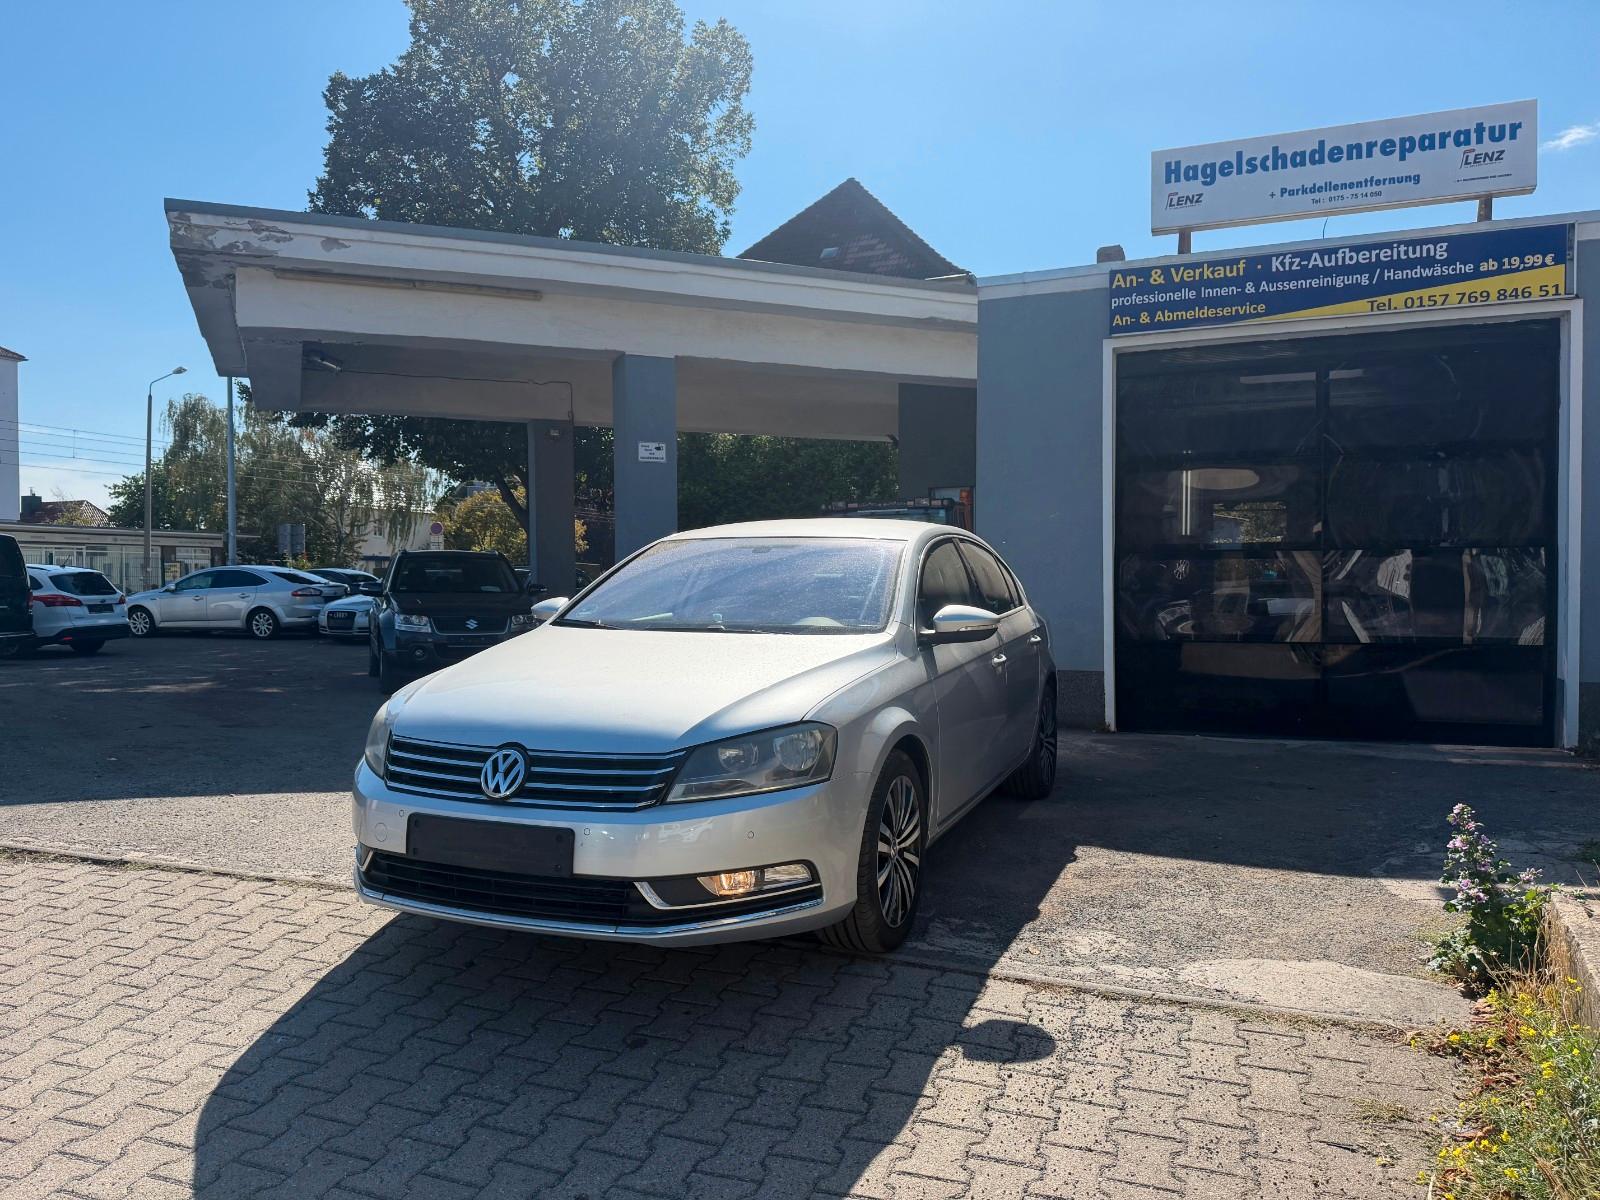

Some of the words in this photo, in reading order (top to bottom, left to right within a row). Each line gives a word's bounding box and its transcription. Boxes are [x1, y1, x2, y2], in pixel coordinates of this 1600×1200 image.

[1164, 121, 1522, 187] Hagelschadenreparatur
[1462, 148, 1506, 167] LENZ
[1280, 173, 1421, 198] Parkdellenentfernung
[1167, 192, 1204, 209] LENZ
[1328, 194, 1345, 203] 0175
[1112, 273, 1144, 289] An-
[1150, 269, 1165, 285] &
[1171, 259, 1246, 283] Verkauf
[1271, 242, 1449, 272] Kfz-Aufbereitung
[1111, 288, 1197, 309] professionelle
[1201, 285, 1242, 298] Innen-
[1245, 281, 1256, 294] &
[1258, 273, 1369, 293] Aussenreinigung
[1384, 261, 1474, 281] Handwäsche
[1479, 258, 1498, 272] ab
[1367, 298, 1398, 313] Tel.
[1404, 293, 1450, 310] 0157
[1456, 290, 1490, 305] 769
[1496, 286, 1532, 302] 846
[1538, 283, 1562, 297] 51
[1112, 314, 1136, 326] An-
[1139, 311, 1151, 324] &
[1154, 301, 1266, 322] Abmeldeservice
